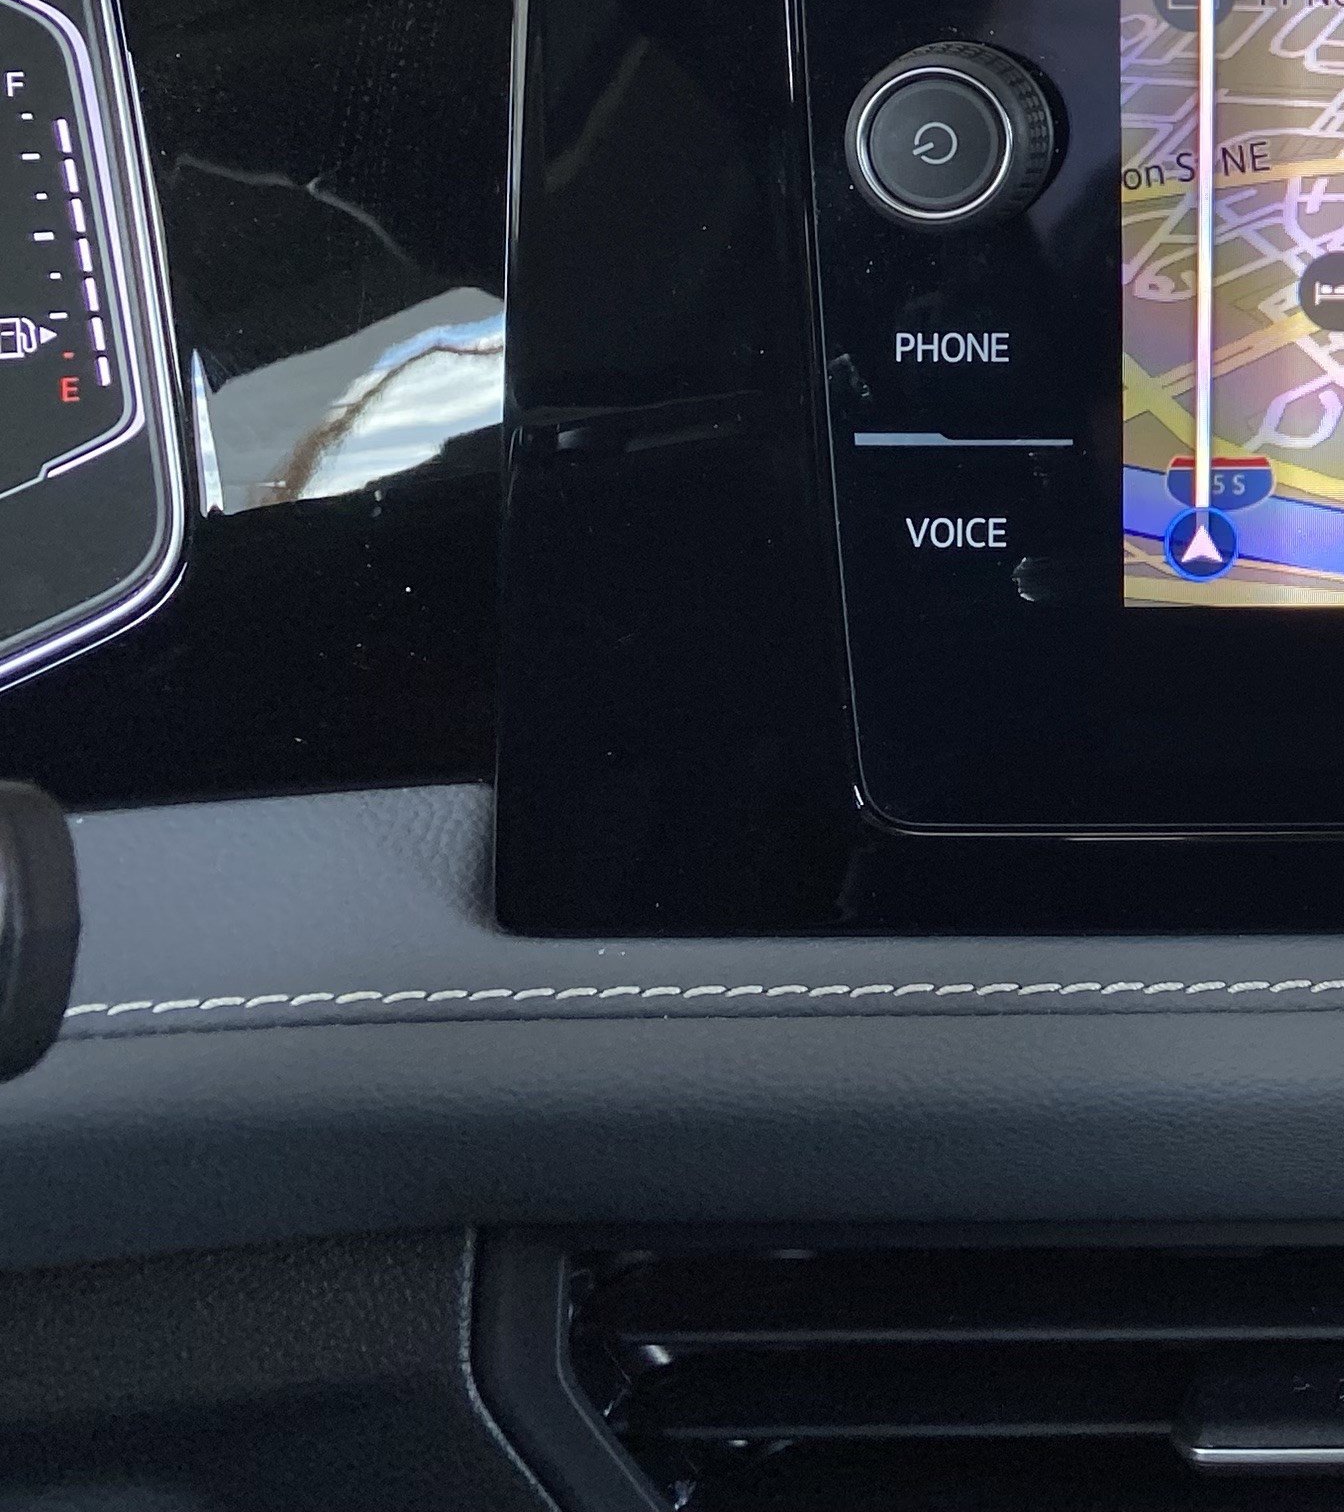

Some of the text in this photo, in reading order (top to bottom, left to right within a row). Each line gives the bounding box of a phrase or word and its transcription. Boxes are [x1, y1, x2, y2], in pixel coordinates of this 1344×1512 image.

[6, 71, 25, 98] F
[1221, 141, 1271, 177] NE
[895, 332, 1010, 363] PHONE
[61, 376, 81, 402] E
[1232, 473, 1246, 495] S
[905, 517, 1007, 548] VOICE
